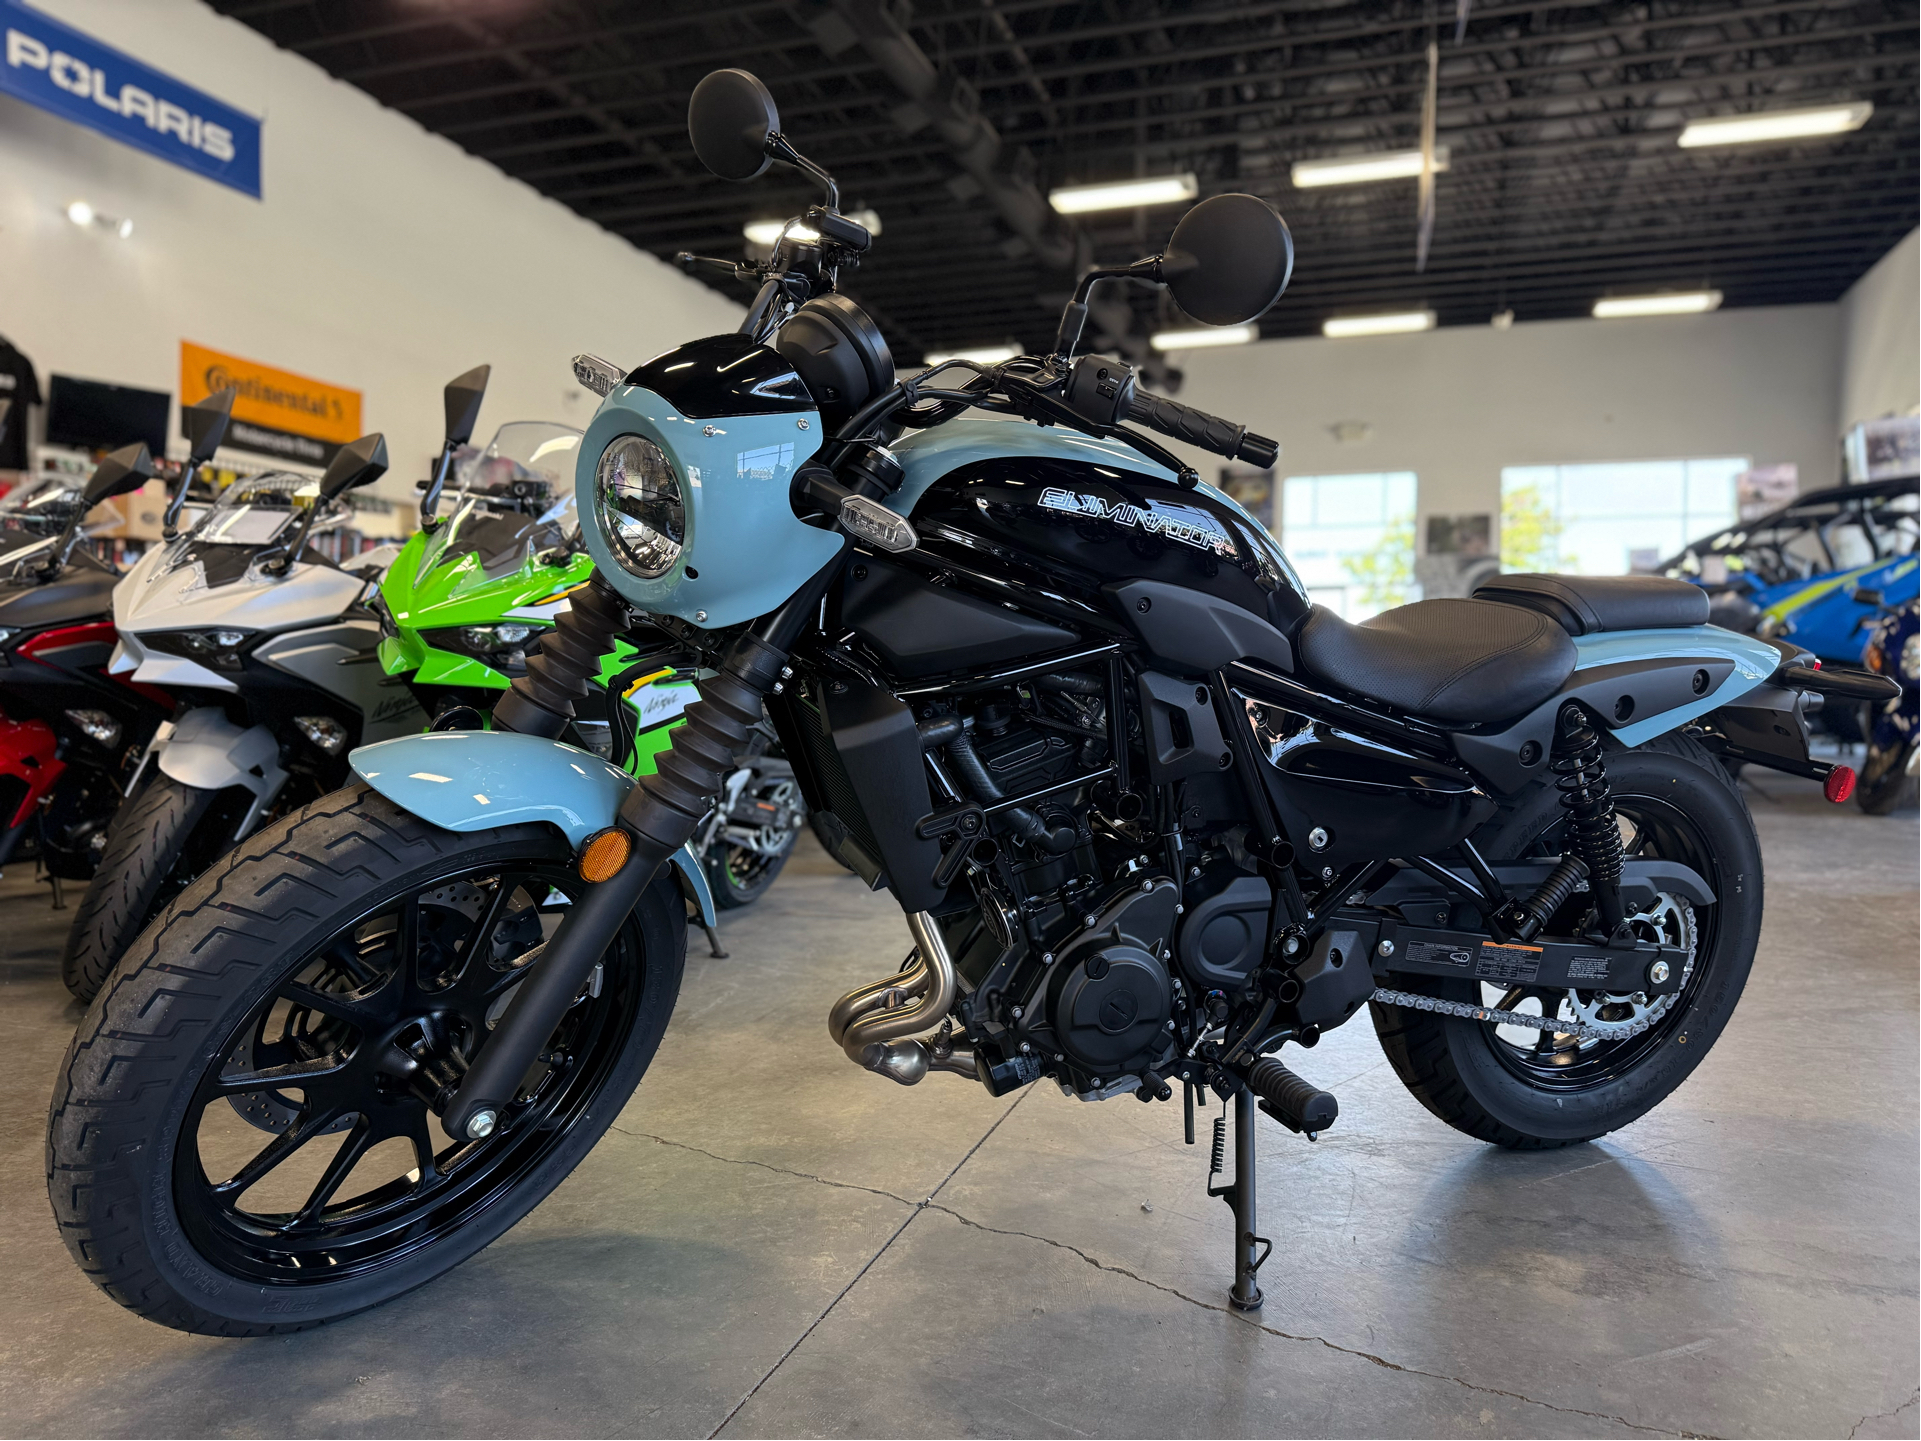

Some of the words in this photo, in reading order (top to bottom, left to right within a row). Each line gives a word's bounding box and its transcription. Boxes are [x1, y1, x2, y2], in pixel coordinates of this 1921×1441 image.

[6, 27, 236, 163] POLARIS
[205, 365, 327, 418] Continental
[1037, 486, 1225, 556] ELIMINATOR
[164, 1239, 225, 1298] GRAND
